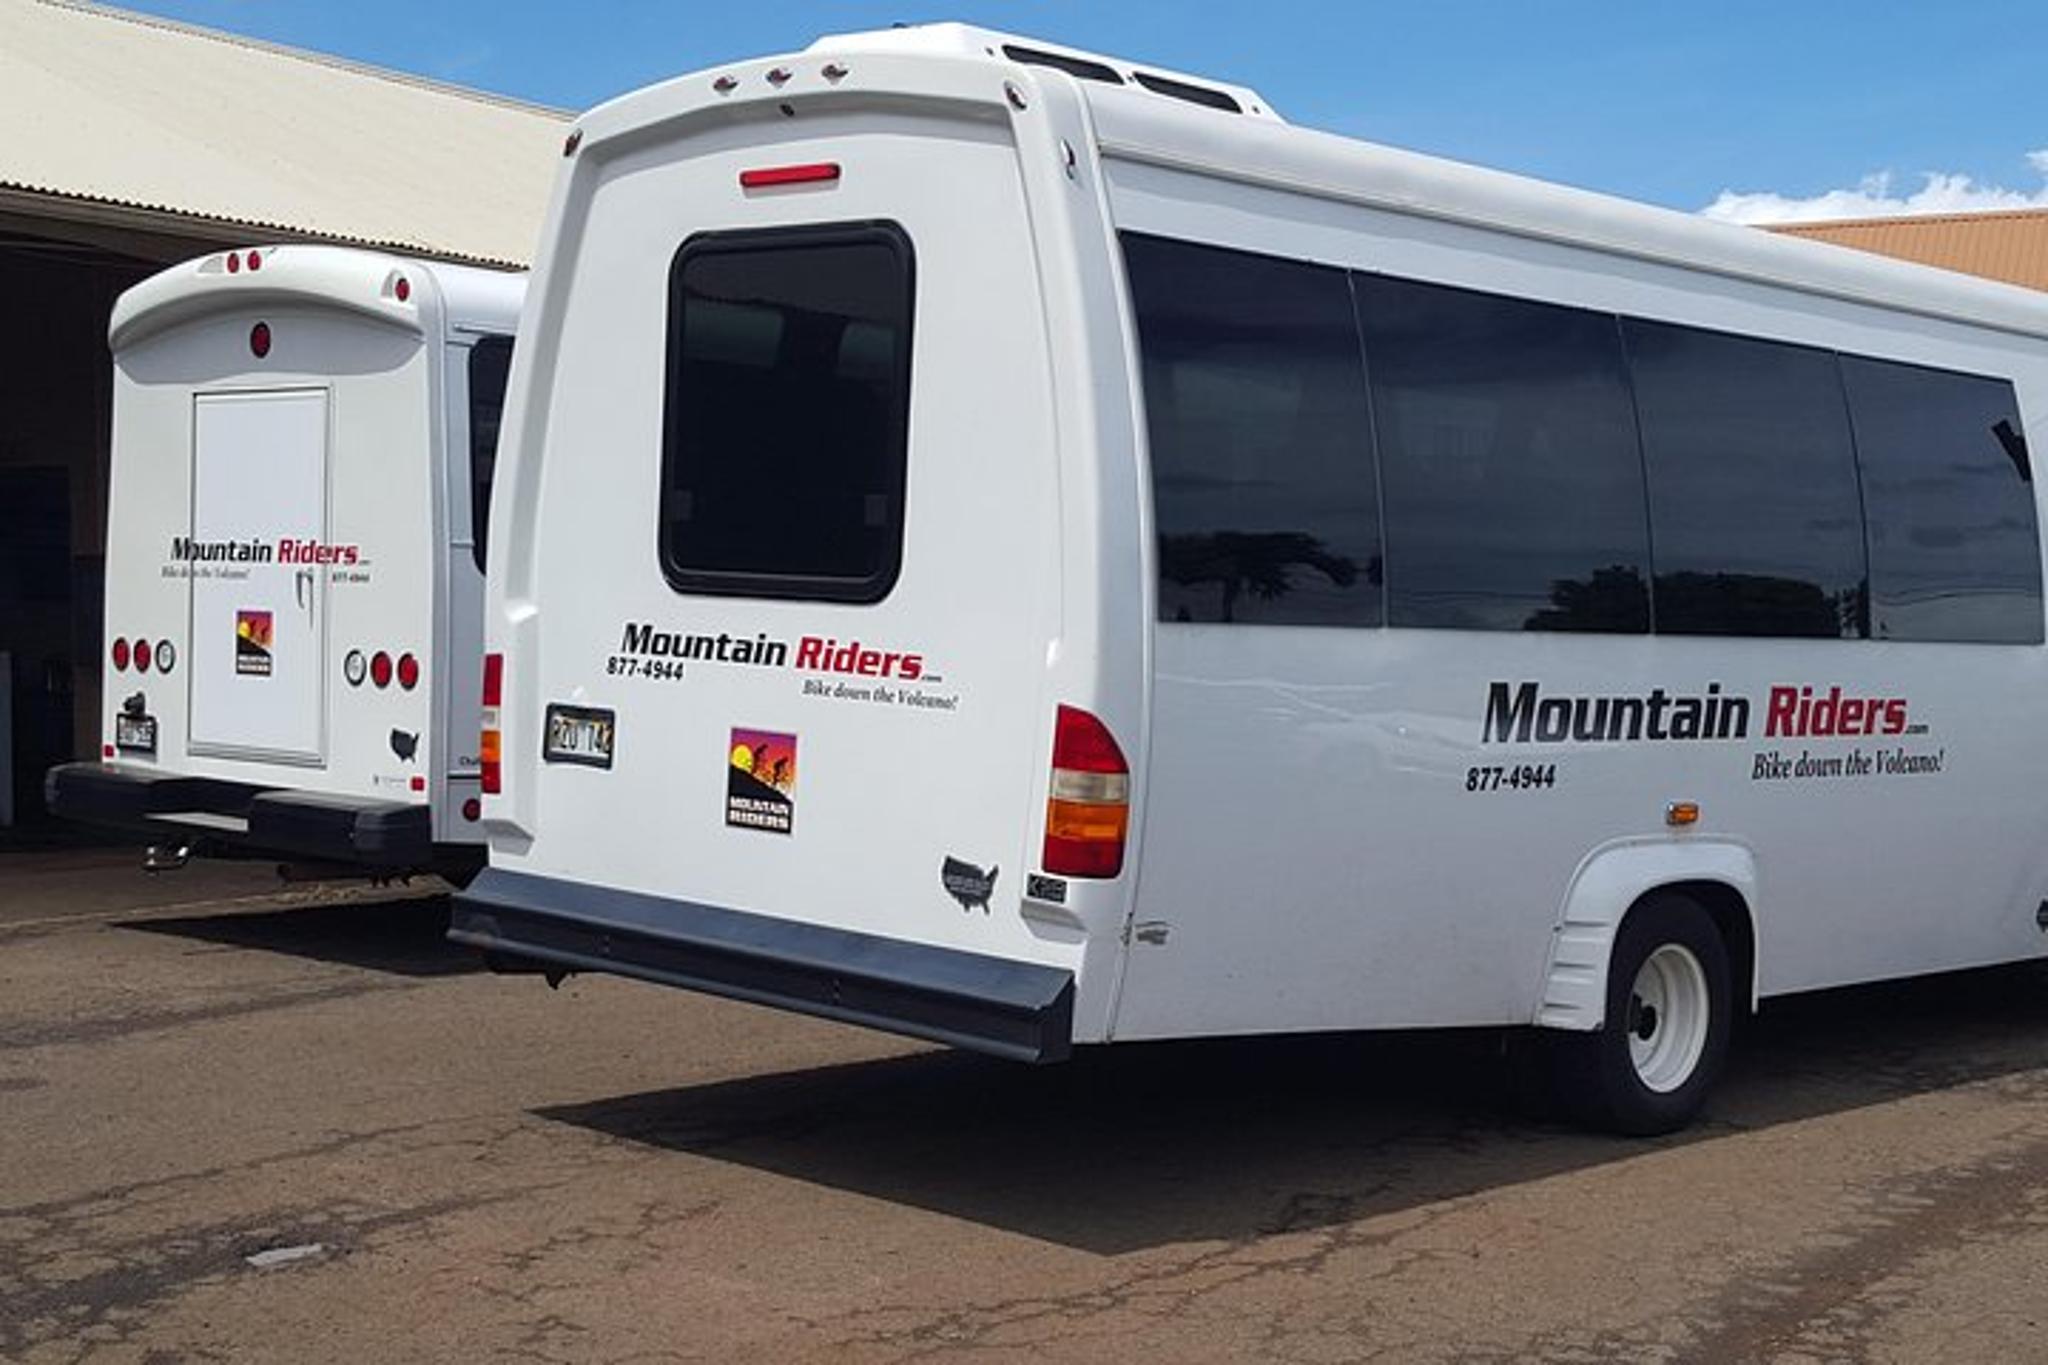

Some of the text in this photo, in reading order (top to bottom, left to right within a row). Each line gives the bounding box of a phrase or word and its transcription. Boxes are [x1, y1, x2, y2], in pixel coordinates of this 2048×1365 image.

[171, 538, 272, 562] Mountain
[622, 623, 788, 666] Mountain
[606, 656, 684, 681] 877-4944
[802, 679, 959, 711] Bike down the Volcano!
[1481, 682, 1750, 743] Mountain
[1465, 764, 1556, 792] 877-4944
[1752, 748, 1944, 780] Bike down the Volcano!
[729, 809, 789, 830] RIDERS
[730, 796, 789, 815] MOUNTAIN
